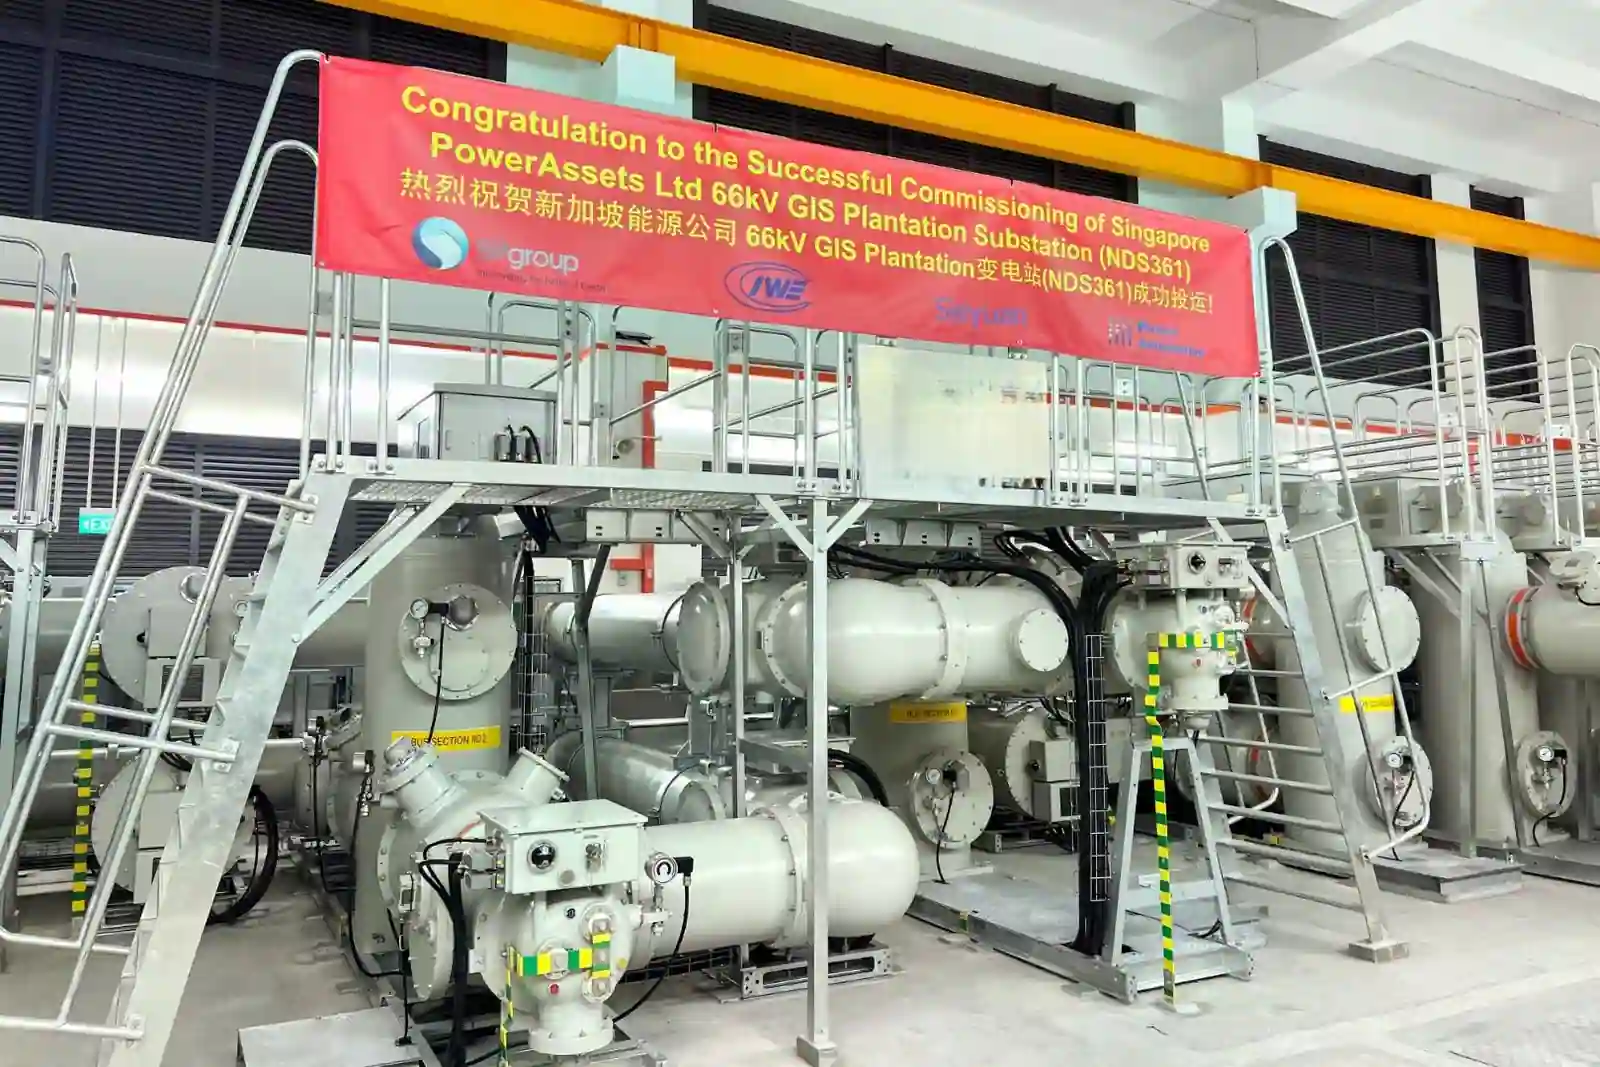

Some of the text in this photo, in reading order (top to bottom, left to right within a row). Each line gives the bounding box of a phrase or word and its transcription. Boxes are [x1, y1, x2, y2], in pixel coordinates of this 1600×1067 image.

[400, 167, 737, 247] 热烈祝贺新加坡能源公司
[745, 224, 807, 254] 66kV
[814, 235, 857, 262] GIS
[401, 85, 1210, 254] Congratulation to the Successful Commissioning of Singapore
[429, 131, 1191, 284] PowerAssets Ltd 66kV GIS Plantation Substation (NDS361)
[431, 735, 469, 746] SECTION
